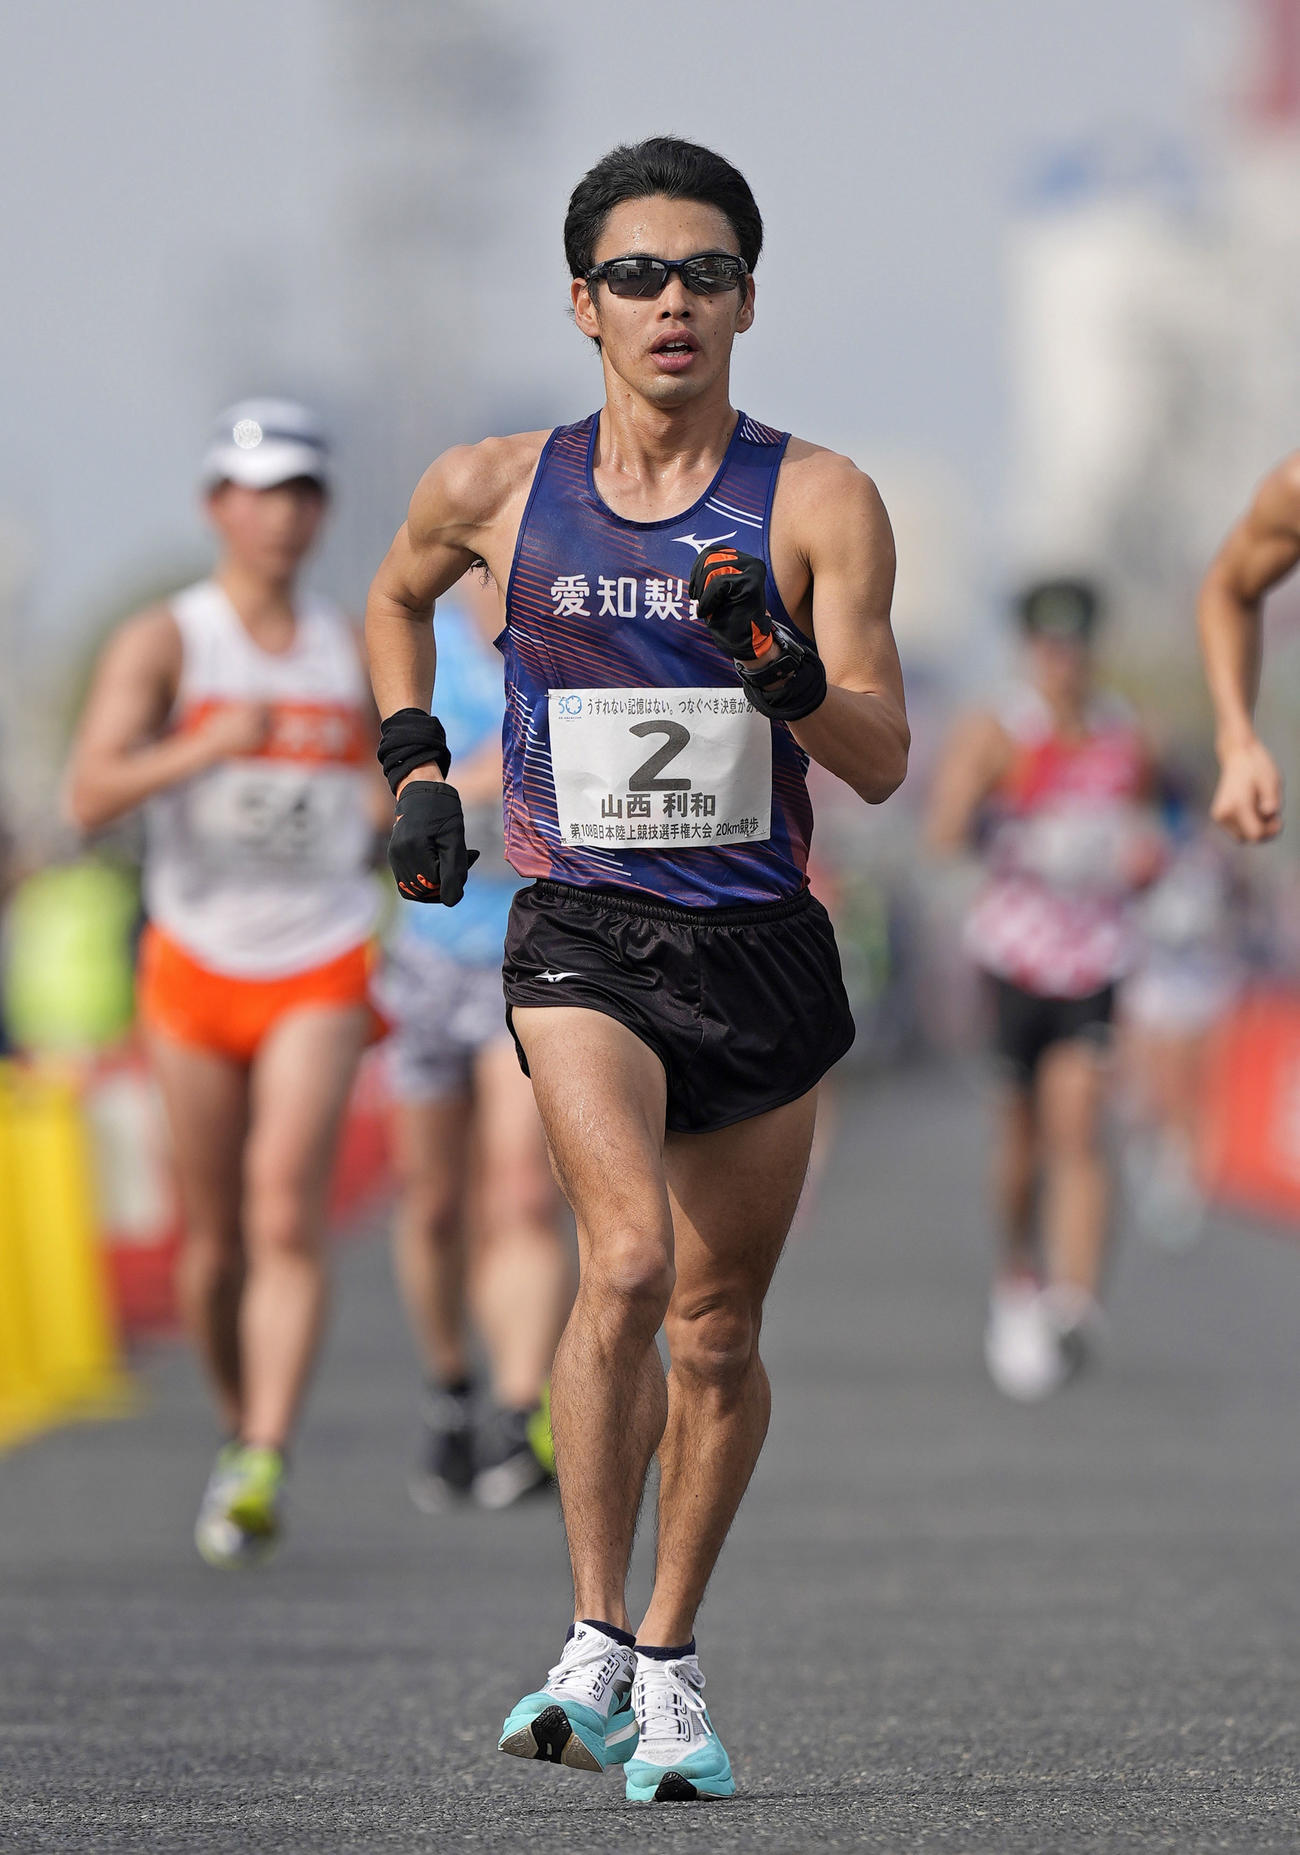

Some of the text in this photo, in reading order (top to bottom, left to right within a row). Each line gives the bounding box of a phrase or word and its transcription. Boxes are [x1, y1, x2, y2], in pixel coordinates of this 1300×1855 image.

[550, 574, 701, 621] 愛知製
[587, 697, 760, 716] うすれない記憶はない。つなぐべき決意があ
[628, 719, 692, 792] 2
[601, 792, 716, 818] 山西 利和
